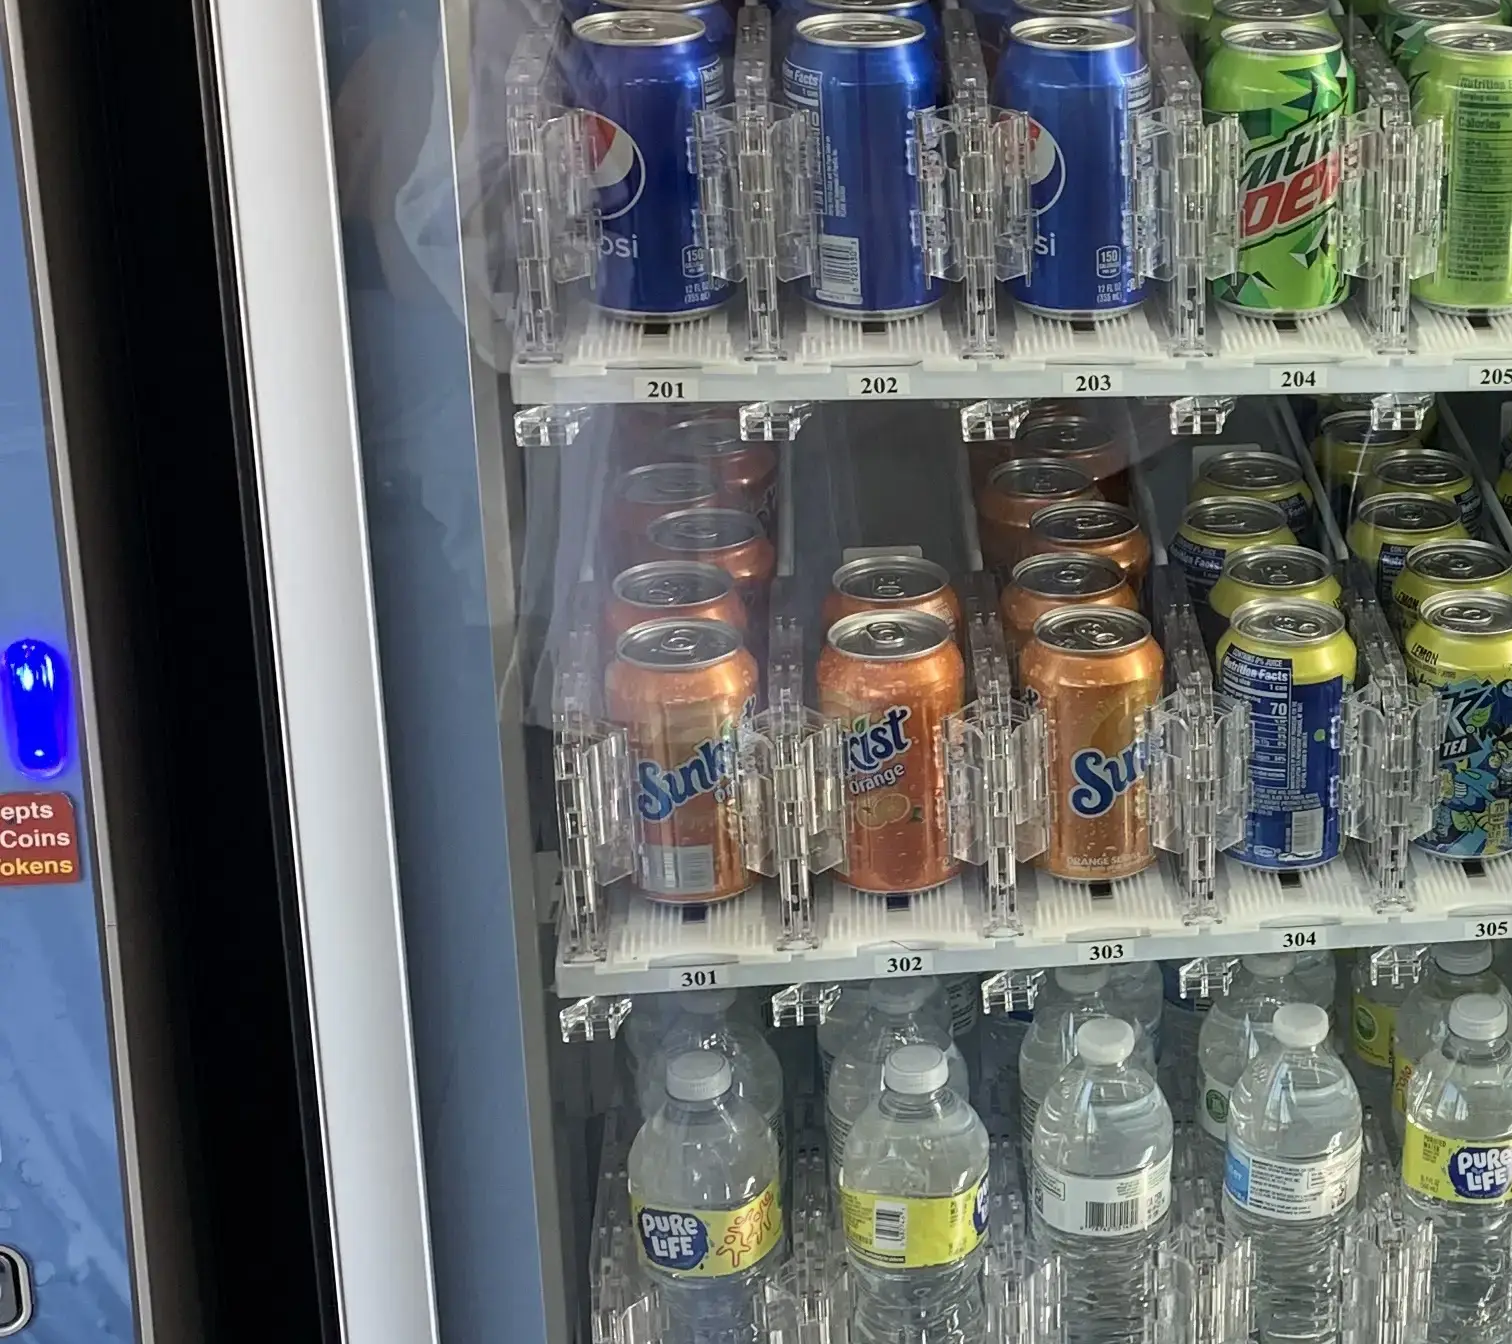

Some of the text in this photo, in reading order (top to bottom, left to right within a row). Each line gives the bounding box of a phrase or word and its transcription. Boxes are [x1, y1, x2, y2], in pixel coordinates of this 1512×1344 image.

[1100, 249, 1118, 263] 150
[860, 375, 899, 394] 202
[1075, 373, 1113, 392] 203
[1280, 369, 1317, 388] 204
[647, 380, 687, 399] 201
[1410, 641, 1439, 665] LEMON
[1259, 669, 1289, 682] Facts
[1270, 702, 1288, 715] 70
[1443, 737, 1468, 757] TEA
[850, 763, 905, 795] Orange
[0, 829, 71, 849] Coins
[0, 858, 73, 876] okens
[1475, 920, 1509, 938] 305
[1282, 931, 1318, 948] 304
[1088, 943, 1125, 962] 303
[886, 955, 923, 974] 302
[681, 968, 718, 988] 301
